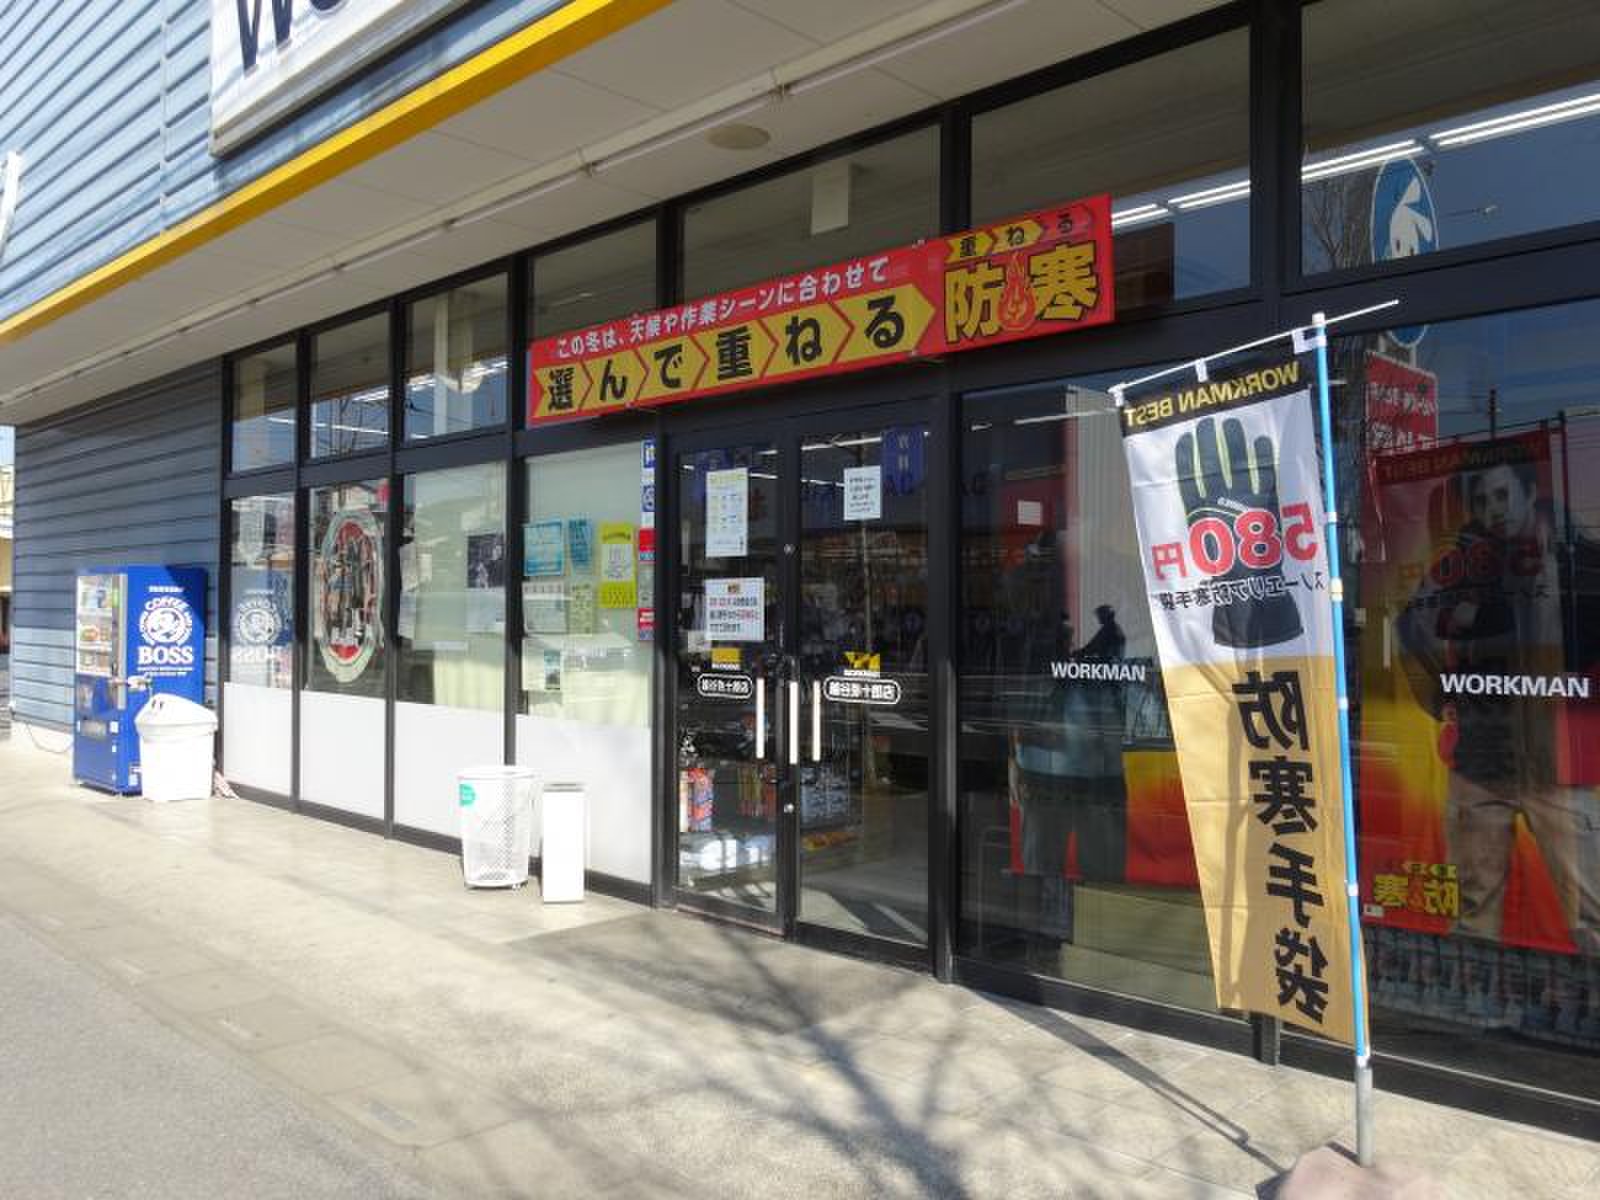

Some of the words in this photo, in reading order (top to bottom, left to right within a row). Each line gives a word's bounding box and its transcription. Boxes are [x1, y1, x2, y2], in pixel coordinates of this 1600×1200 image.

[944, 242, 1098, 343] 防寒
[547, 294, 906, 413] 選んで重ねる
[138, 646, 194, 666] BOSS
[1051, 661, 1146, 682] WORKMAN
[1440, 672, 1590, 699] WORKMAN
